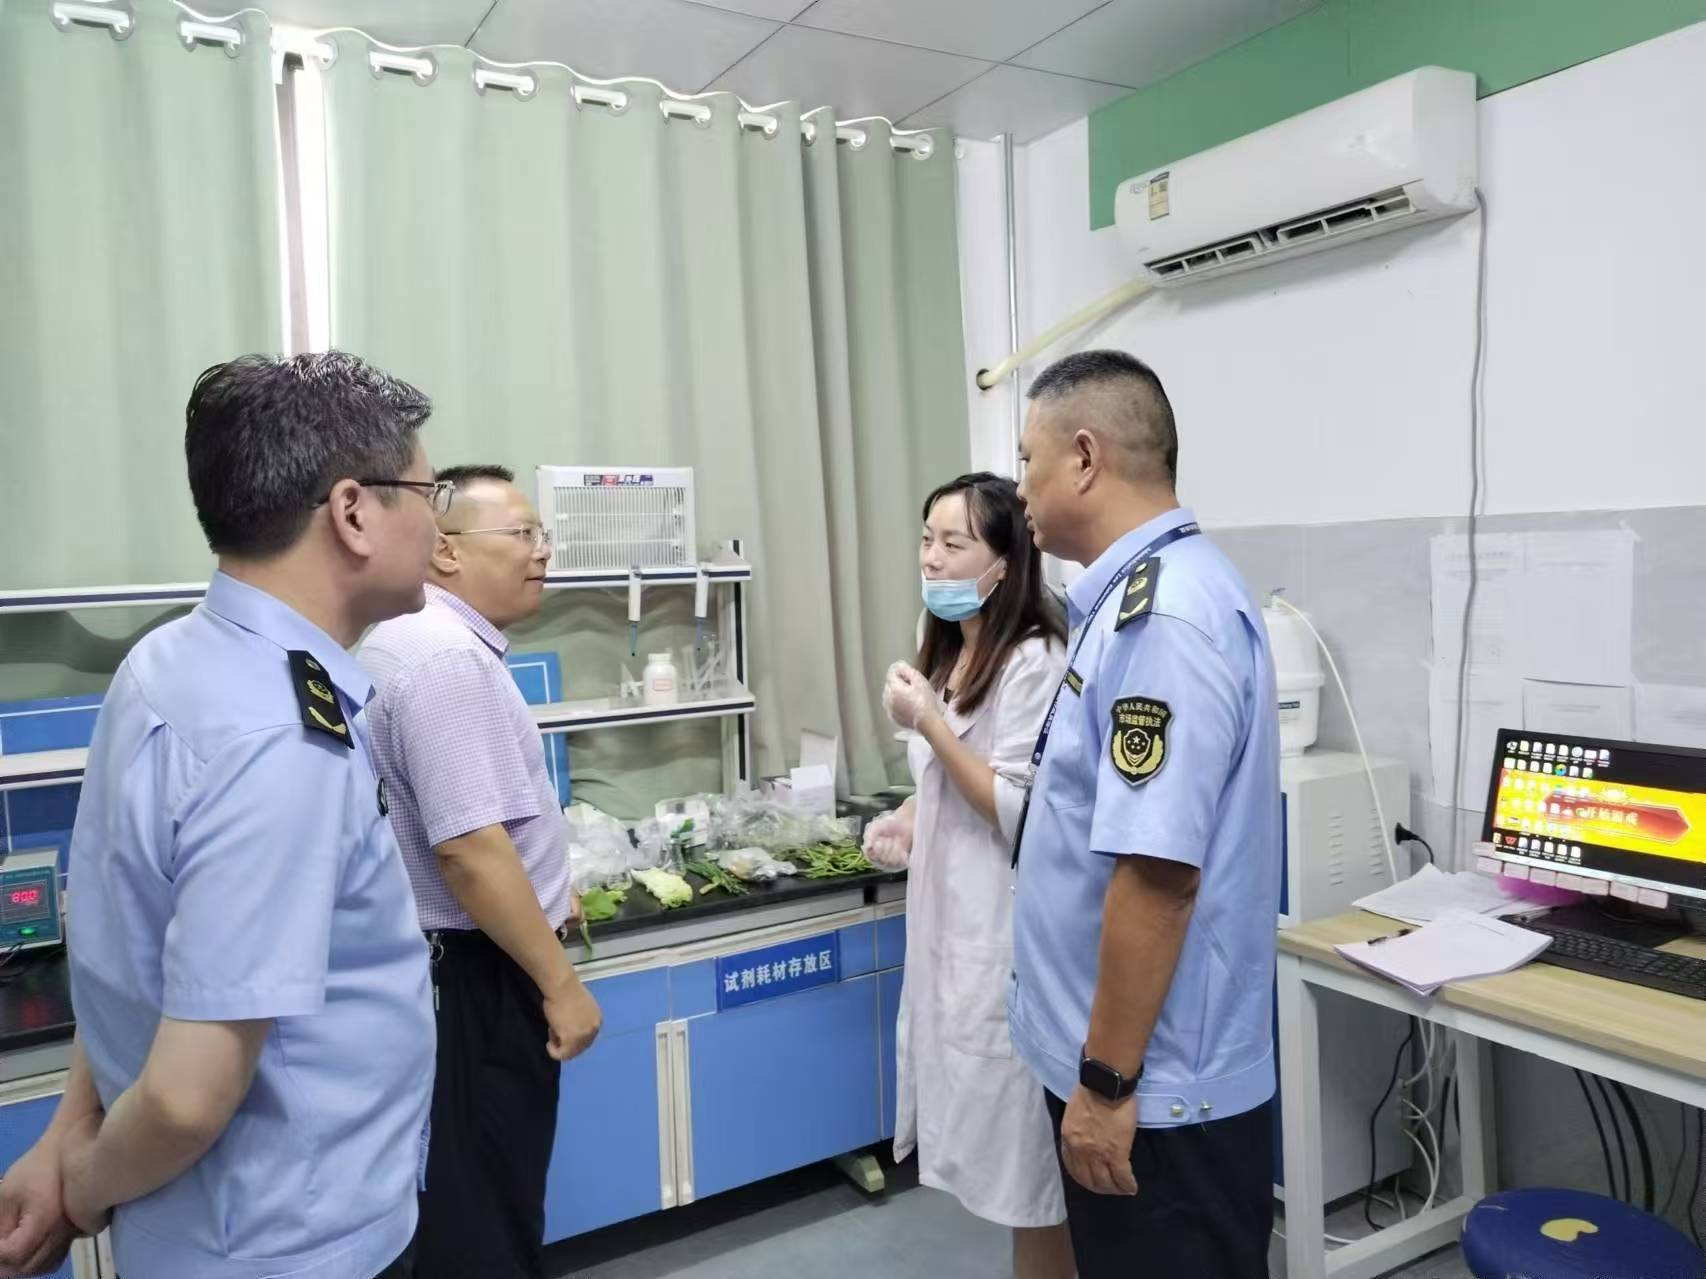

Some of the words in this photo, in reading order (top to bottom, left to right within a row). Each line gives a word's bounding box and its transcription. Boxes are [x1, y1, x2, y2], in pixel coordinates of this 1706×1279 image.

[724, 950, 832, 993] 试剂耗材存放区
